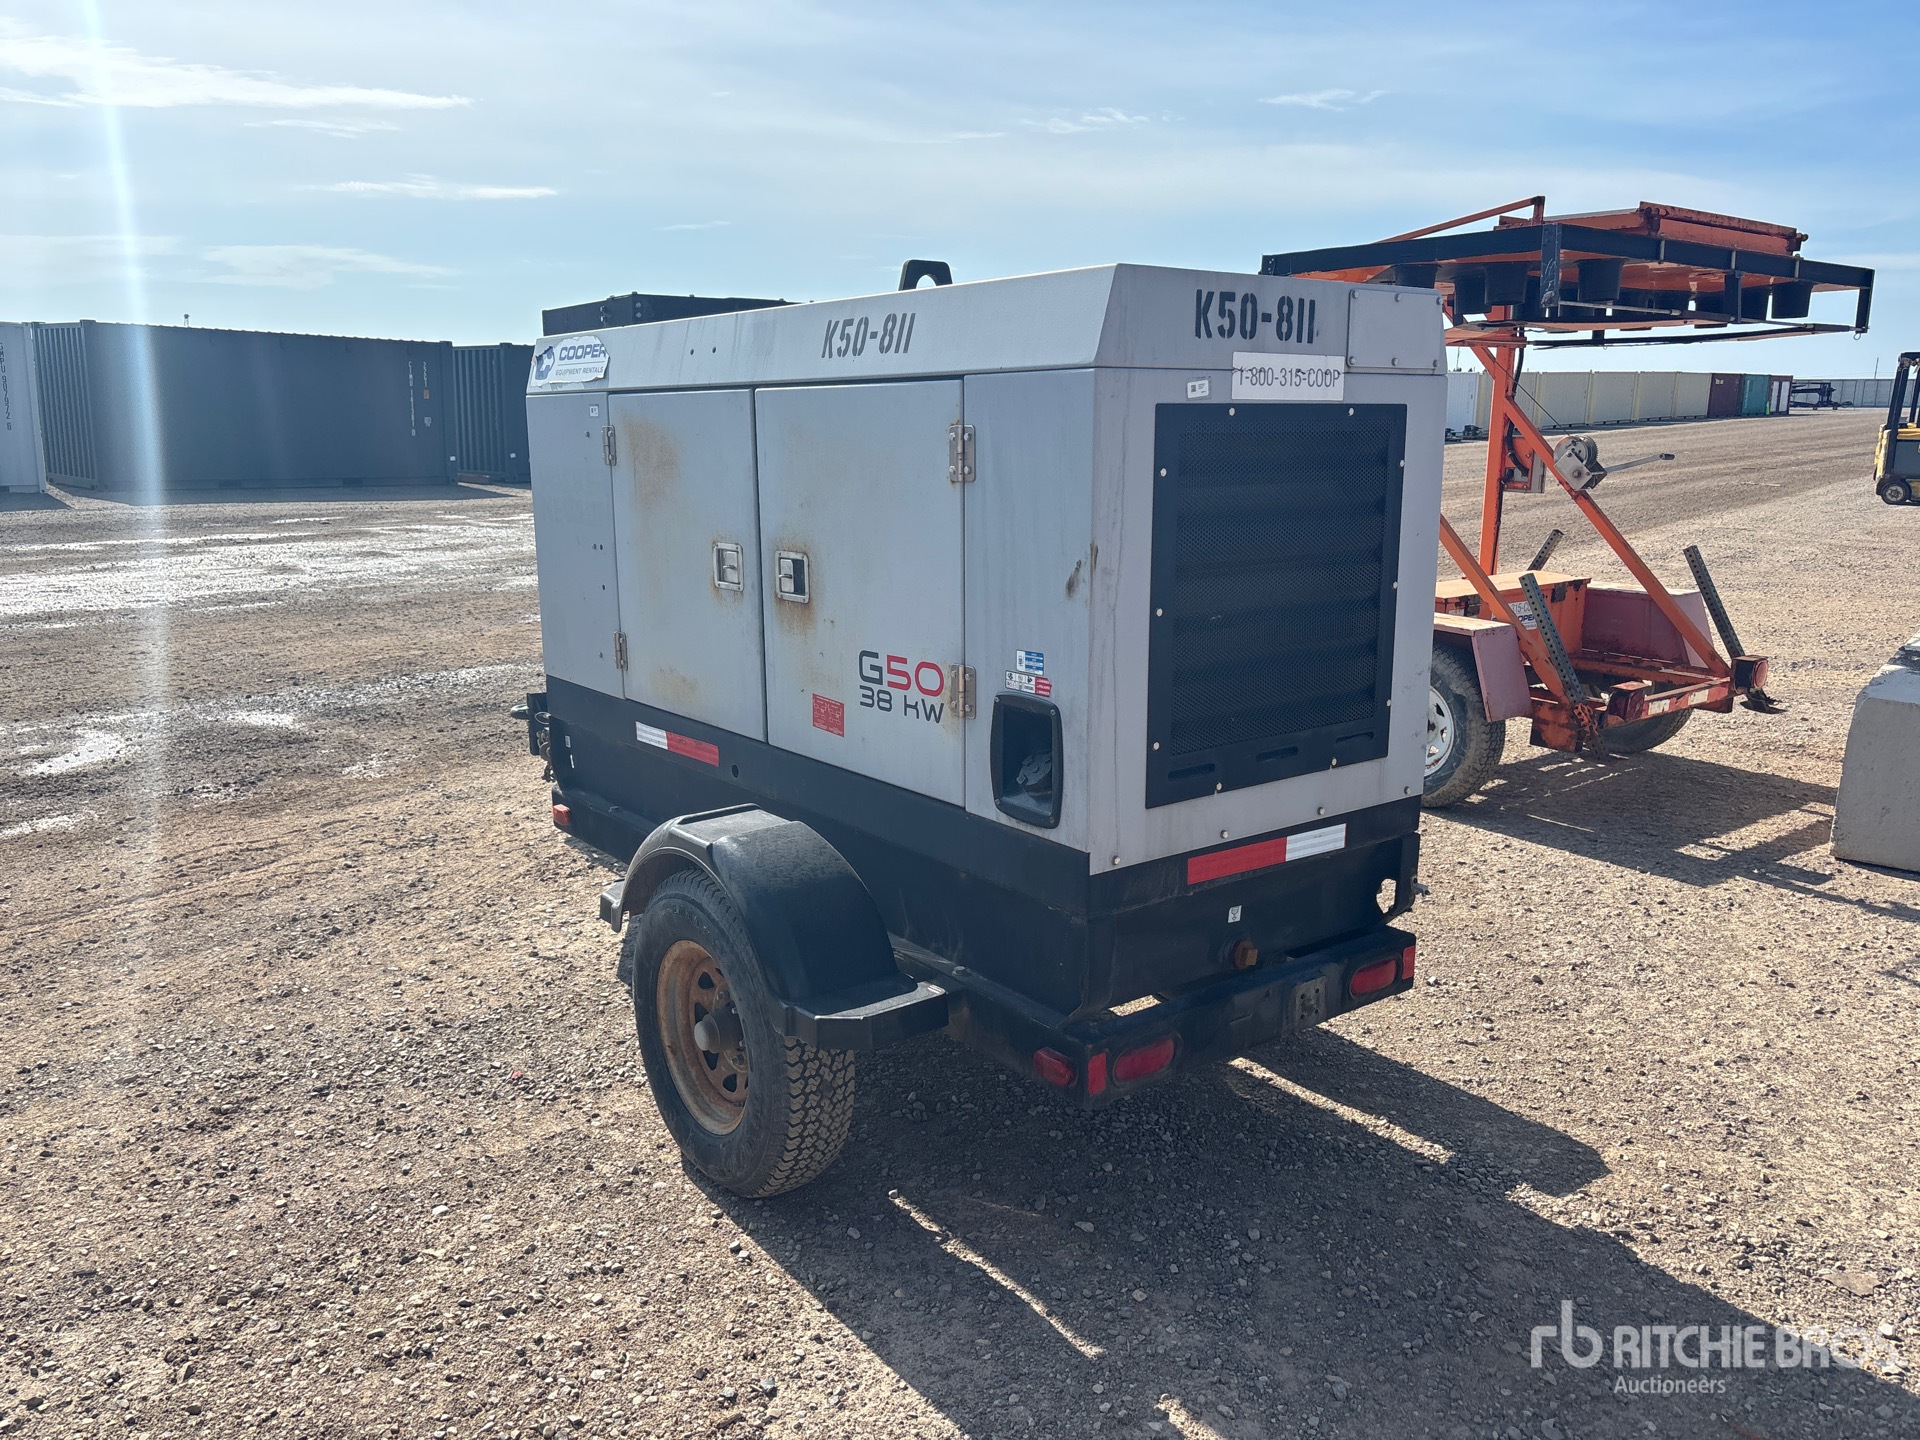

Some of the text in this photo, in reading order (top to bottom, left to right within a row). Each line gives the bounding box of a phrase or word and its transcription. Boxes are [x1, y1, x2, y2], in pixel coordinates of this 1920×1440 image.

[1195, 289, 1316, 344] K50-811
[821, 312, 917, 360] K50-811
[559, 343, 606, 361] COOPER
[555, 366, 604, 376] EQUIPMENT RENTALS
[1239, 366, 1341, 388] 1-800-315-COOP
[858, 650, 945, 697] G50
[859, 685, 893, 712] 38
